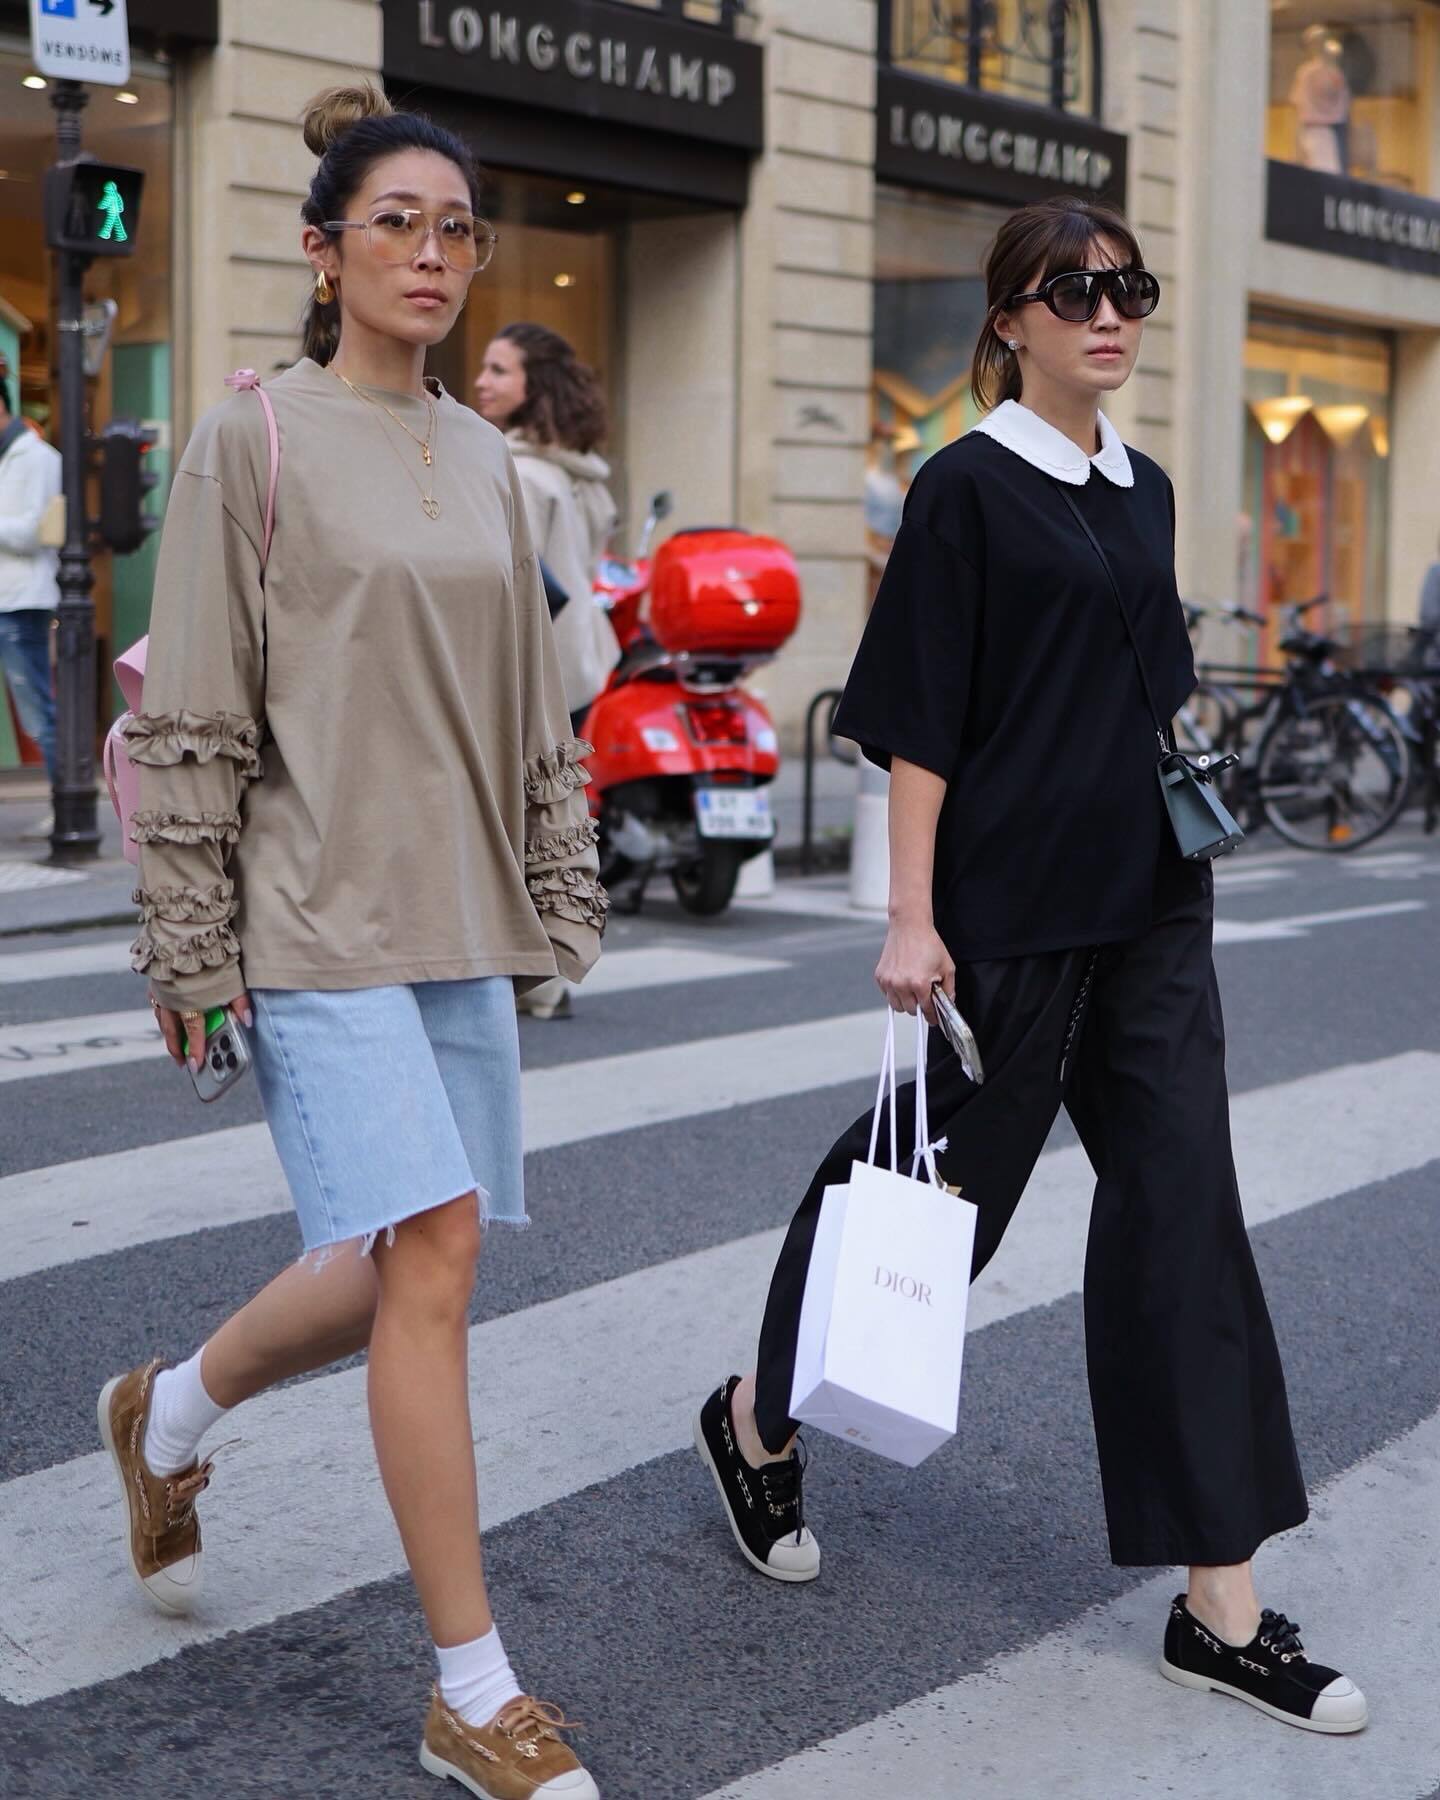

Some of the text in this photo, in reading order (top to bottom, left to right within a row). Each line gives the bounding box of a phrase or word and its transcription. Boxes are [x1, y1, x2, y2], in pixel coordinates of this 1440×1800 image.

[418, 0, 736, 106] LONGCHAMP
[889, 105, 1112, 189] LONGCHAMP
[874, 1265, 934, 1307] DIOR
